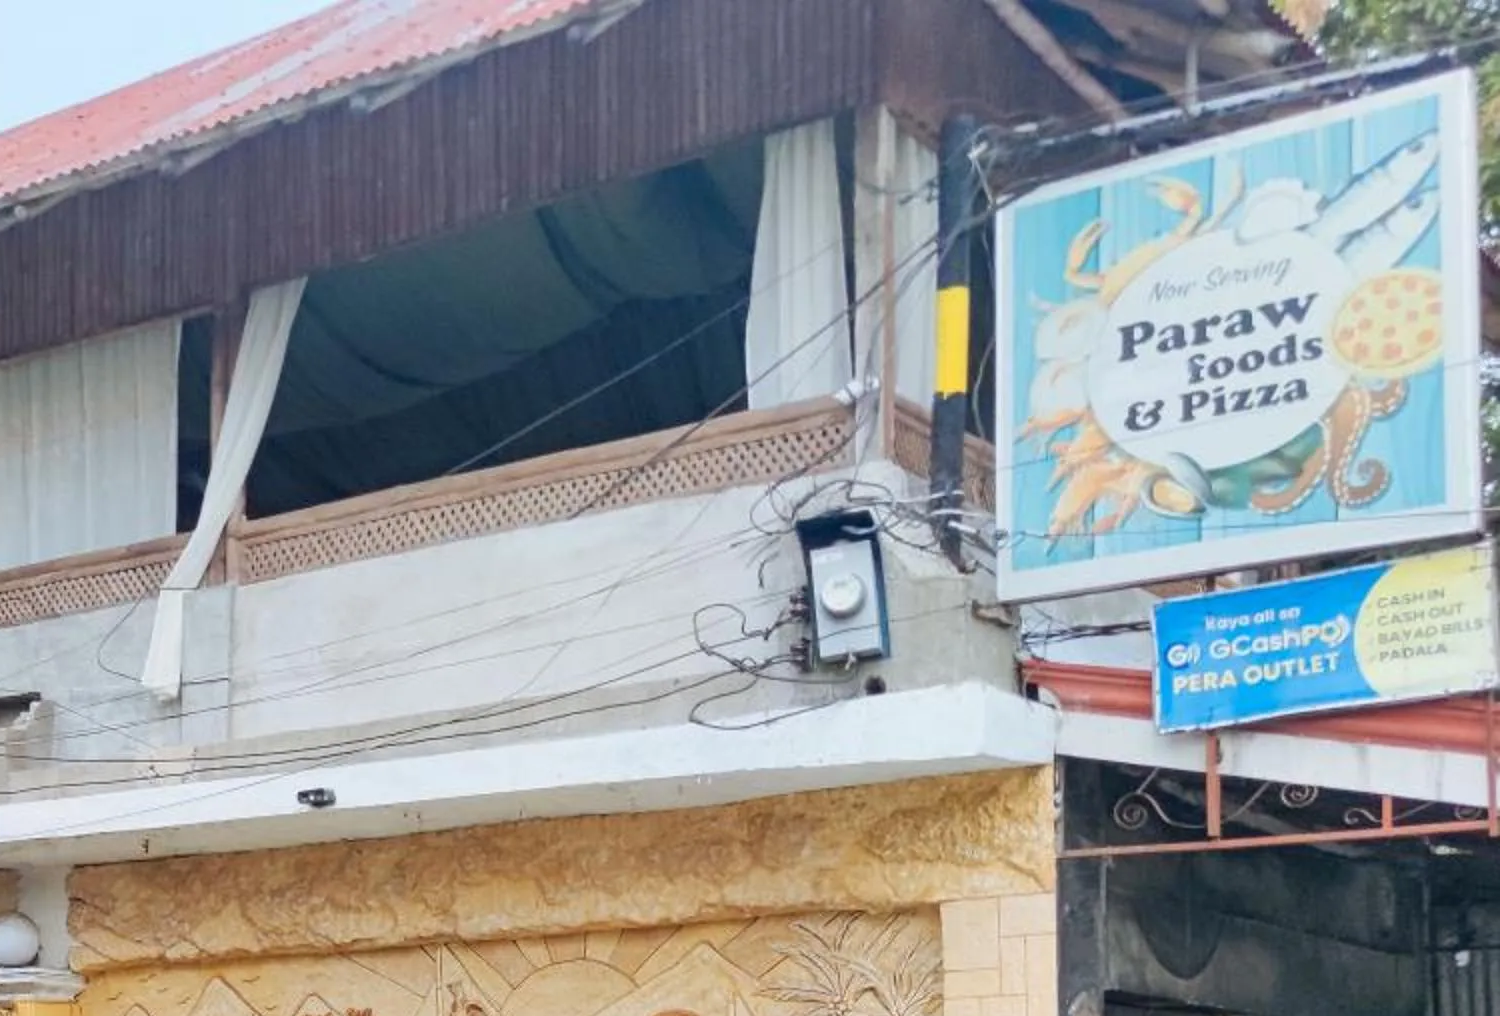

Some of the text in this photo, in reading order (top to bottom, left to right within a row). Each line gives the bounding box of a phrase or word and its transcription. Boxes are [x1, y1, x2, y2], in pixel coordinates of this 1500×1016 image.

[1150, 257, 1292, 303] Now Serving
[1117, 292, 1320, 362] Paraw
[1188, 333, 1324, 385] foods
[1123, 378, 1310, 432] & Pizza
[1377, 592, 1424, 609] CASH
[1377, 602, 1465, 627] CASH OUT
[1377, 617, 1485, 645] BAYAD BILLS
[1379, 644, 1448, 662] PADALA
[1173, 651, 1341, 695] PERA OUTLET
